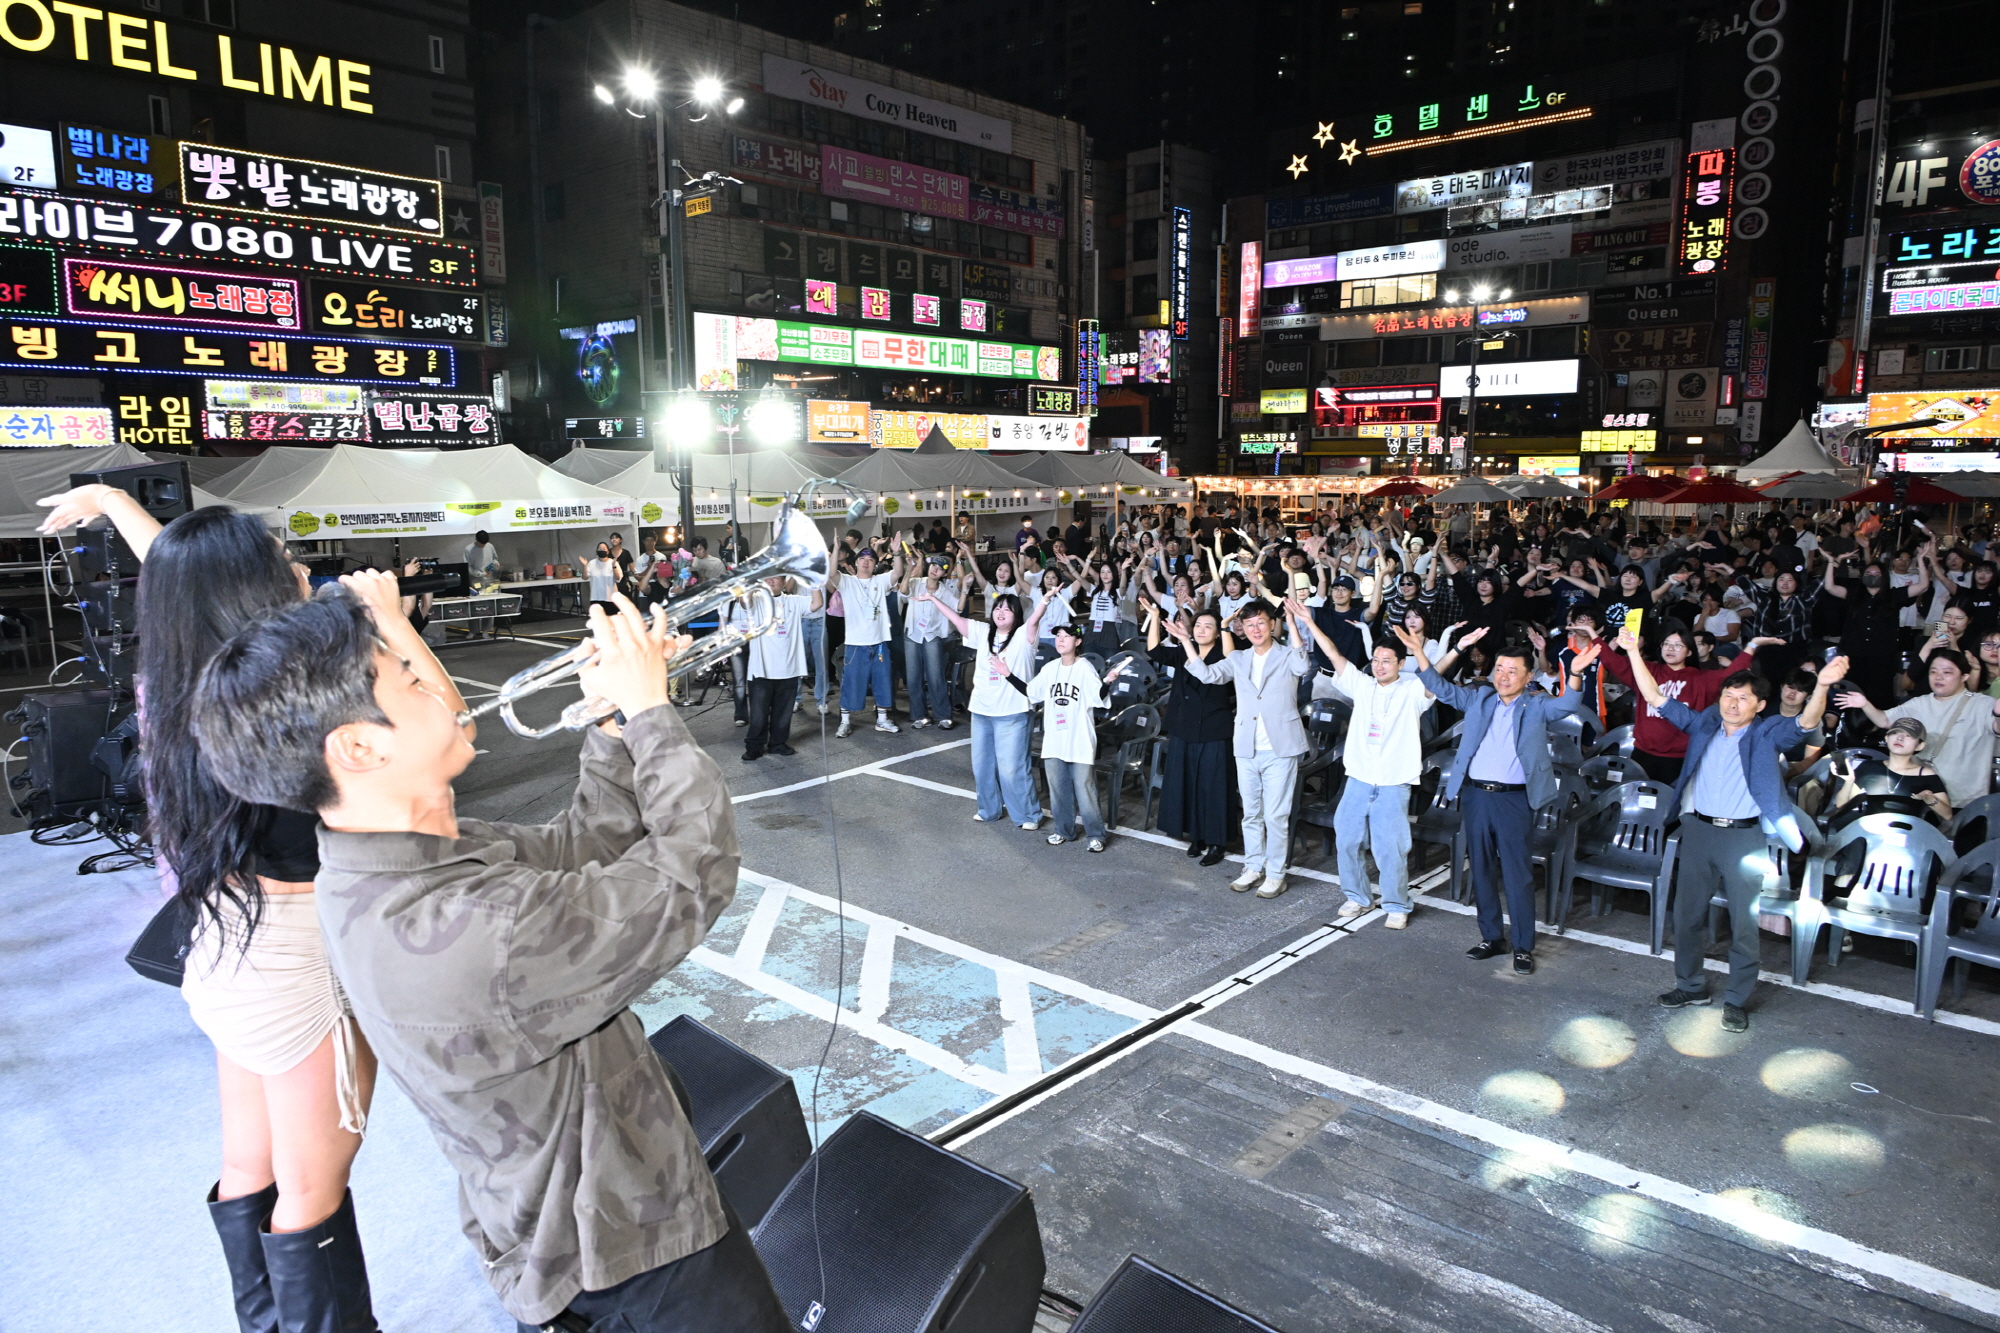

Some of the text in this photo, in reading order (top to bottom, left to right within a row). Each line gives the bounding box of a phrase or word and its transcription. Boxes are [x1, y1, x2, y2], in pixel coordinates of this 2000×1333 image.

[219, 35, 373, 114] LIME
[808, 76, 848, 109] Stay
[1546, 92, 1567, 105] 6F
[865, 92, 901, 120] Cozy
[905, 102, 958, 133] Heaven
[68, 127, 149, 164] 별나라
[738, 139, 821, 181] 우정 노래방
[742, 159, 756, 168] 3F
[1566, 147, 1665, 174] 한국외식업중앙회
[14, 166, 35, 182] 2F
[76, 163, 154, 194] 노래광장
[1431, 166, 1530, 197] 휴 태국마사지
[1566, 162, 1664, 187] 안산시 단원구지부
[1696, 151, 1725, 206] 따봉
[1886, 157, 1949, 208] 4F
[301, 175, 419, 219] 노래광장
[923, 173, 963, 203] 단체반
[1325, 197, 1380, 214] Investment
[148, 215, 294, 259] 7080
[311, 236, 413, 274] LIVE
[429, 258, 459, 275] 3F
[1451, 239, 1479, 253] ode
[1594, 233, 1623, 248] HANG
[1625, 229, 1648, 244] OUT
[1355, 255, 1372, 265] 타투
[1373, 254, 1379, 262] &
[1382, 251, 1415, 263] 두피문신
[1460, 250, 1510, 265] studio.
[1629, 255, 1645, 266] 4F
[1293, 263, 1322, 273] AMAZON
[1634, 283, 1672, 301] No.1
[1892, 278, 1925, 287] Business
[89, 270, 294, 316] 써니 노래광장
[322, 291, 404, 329] 오드리
[410, 312, 474, 335] 노래광장
[463, 298, 479, 310] 2F
[916, 299, 938, 323] 노래
[963, 304, 986, 327] 광장
[1373, 318, 1400, 333] 名品
[1403, 311, 1473, 330] 노래연습장
[1628, 307, 1678, 321] Queen
[813, 329, 849, 343] 고기무한
[1175, 321, 1188, 335] 3F
[1278, 332, 1303, 340] Queen
[1748, 281, 1772, 388] 따봉 노래광장
[1610, 327, 1697, 353] 오페라
[12, 326, 141, 364] 빙고
[183, 336, 408, 377] 노래광장
[813, 347, 849, 361] 소주무한
[884, 338, 969, 370] 무한대패
[1099, 352, 1139, 367] 노래광장
[1238, 345, 1246, 372] BAR
[1618, 353, 1698, 367] 노래광장 3F
[1265, 360, 1303, 374] Queen
[1362, 367, 1407, 383] 노래광장
[828, 403, 850, 413] 의정부
[1036, 390, 1073, 411] 노래광장
[119, 396, 192, 427] 라임
[374, 401, 492, 433] 별난곱창
[1602, 413, 1650, 428] 센스호텔
[1674, 409, 1706, 417] ALLEY
[0, 413, 108, 441] 순자 곱창
[248, 415, 304, 438] 황소
[308, 416, 363, 439] 곱창
[813, 414, 864, 430] 부대찌개
[872, 413, 884, 446] 궁전
[885, 413, 915, 429] 감자탕
[1011, 421, 1070, 442] 중앙 김밥
[1361, 424, 1425, 438] 금산 삼계탕
[119, 427, 193, 445] HOTEL
[1931, 439, 1953, 447] XYM
[325, 516, 337, 525] 27
[515, 510, 527, 518] 26
[529, 505, 592, 519] 본오종합사회복지관
